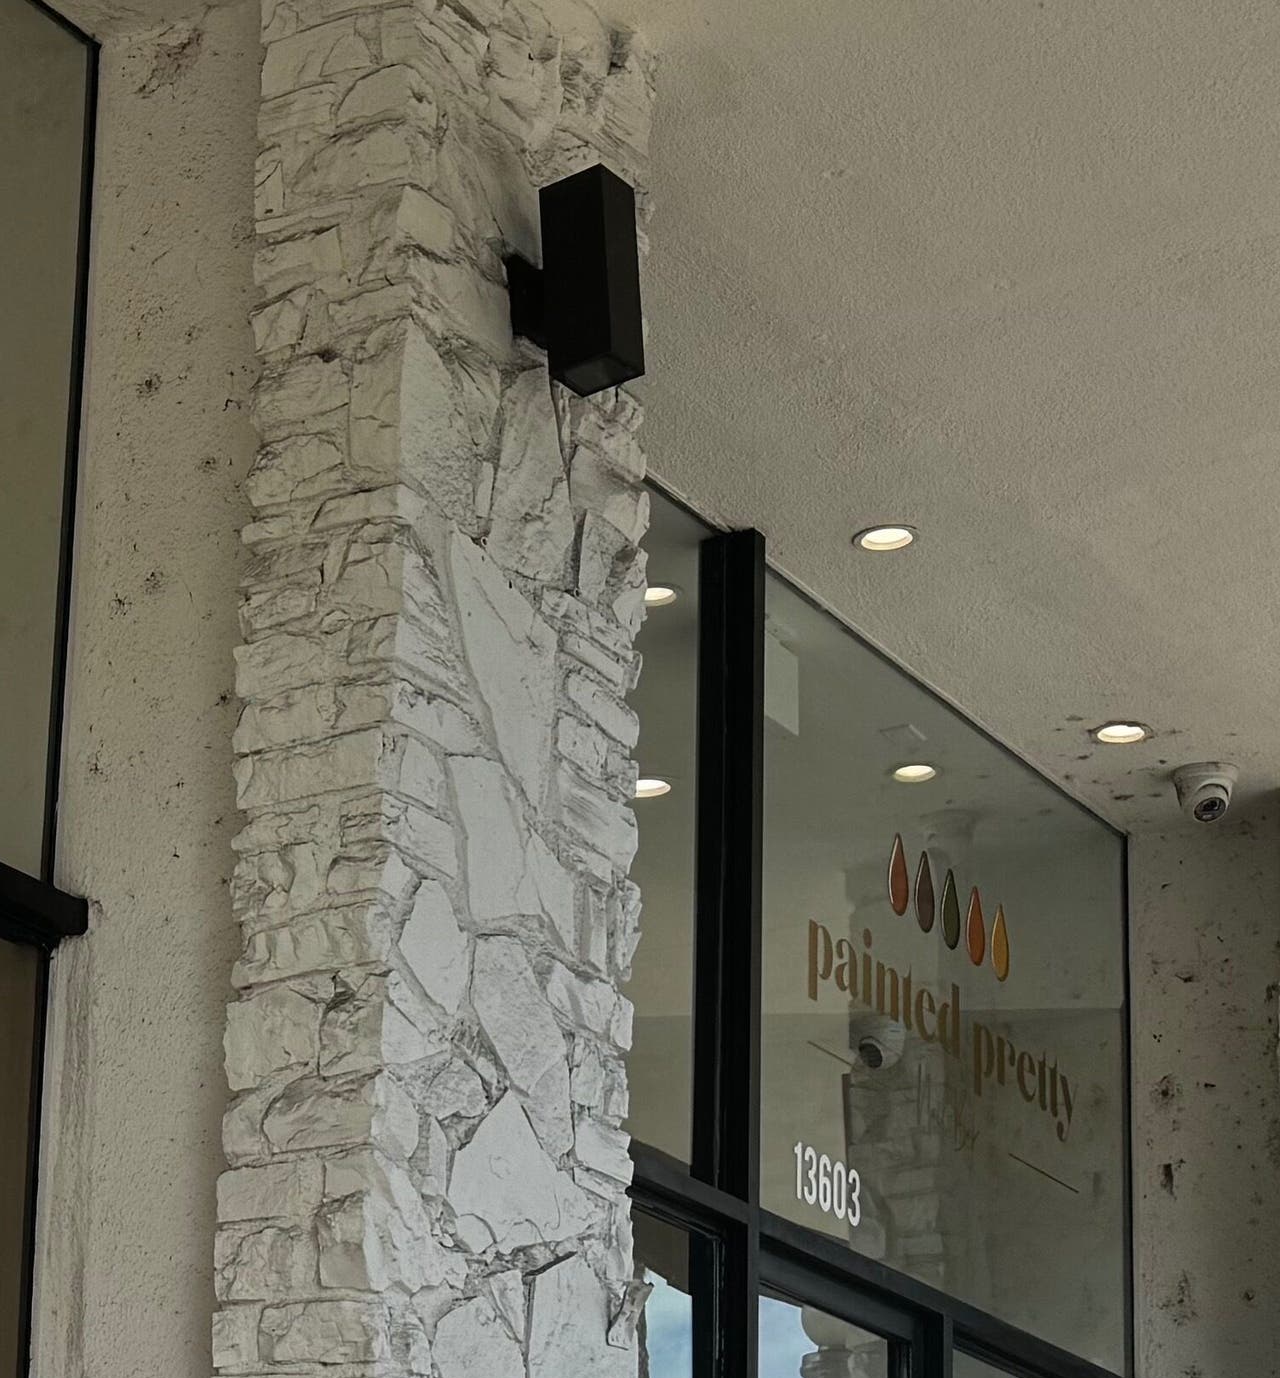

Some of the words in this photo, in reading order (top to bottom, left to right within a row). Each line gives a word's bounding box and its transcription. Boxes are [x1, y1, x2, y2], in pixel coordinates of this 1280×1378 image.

[808, 919, 961, 1059] painted
[974, 1022, 1079, 1143] pretty
[793, 1141, 861, 1228] 13603
